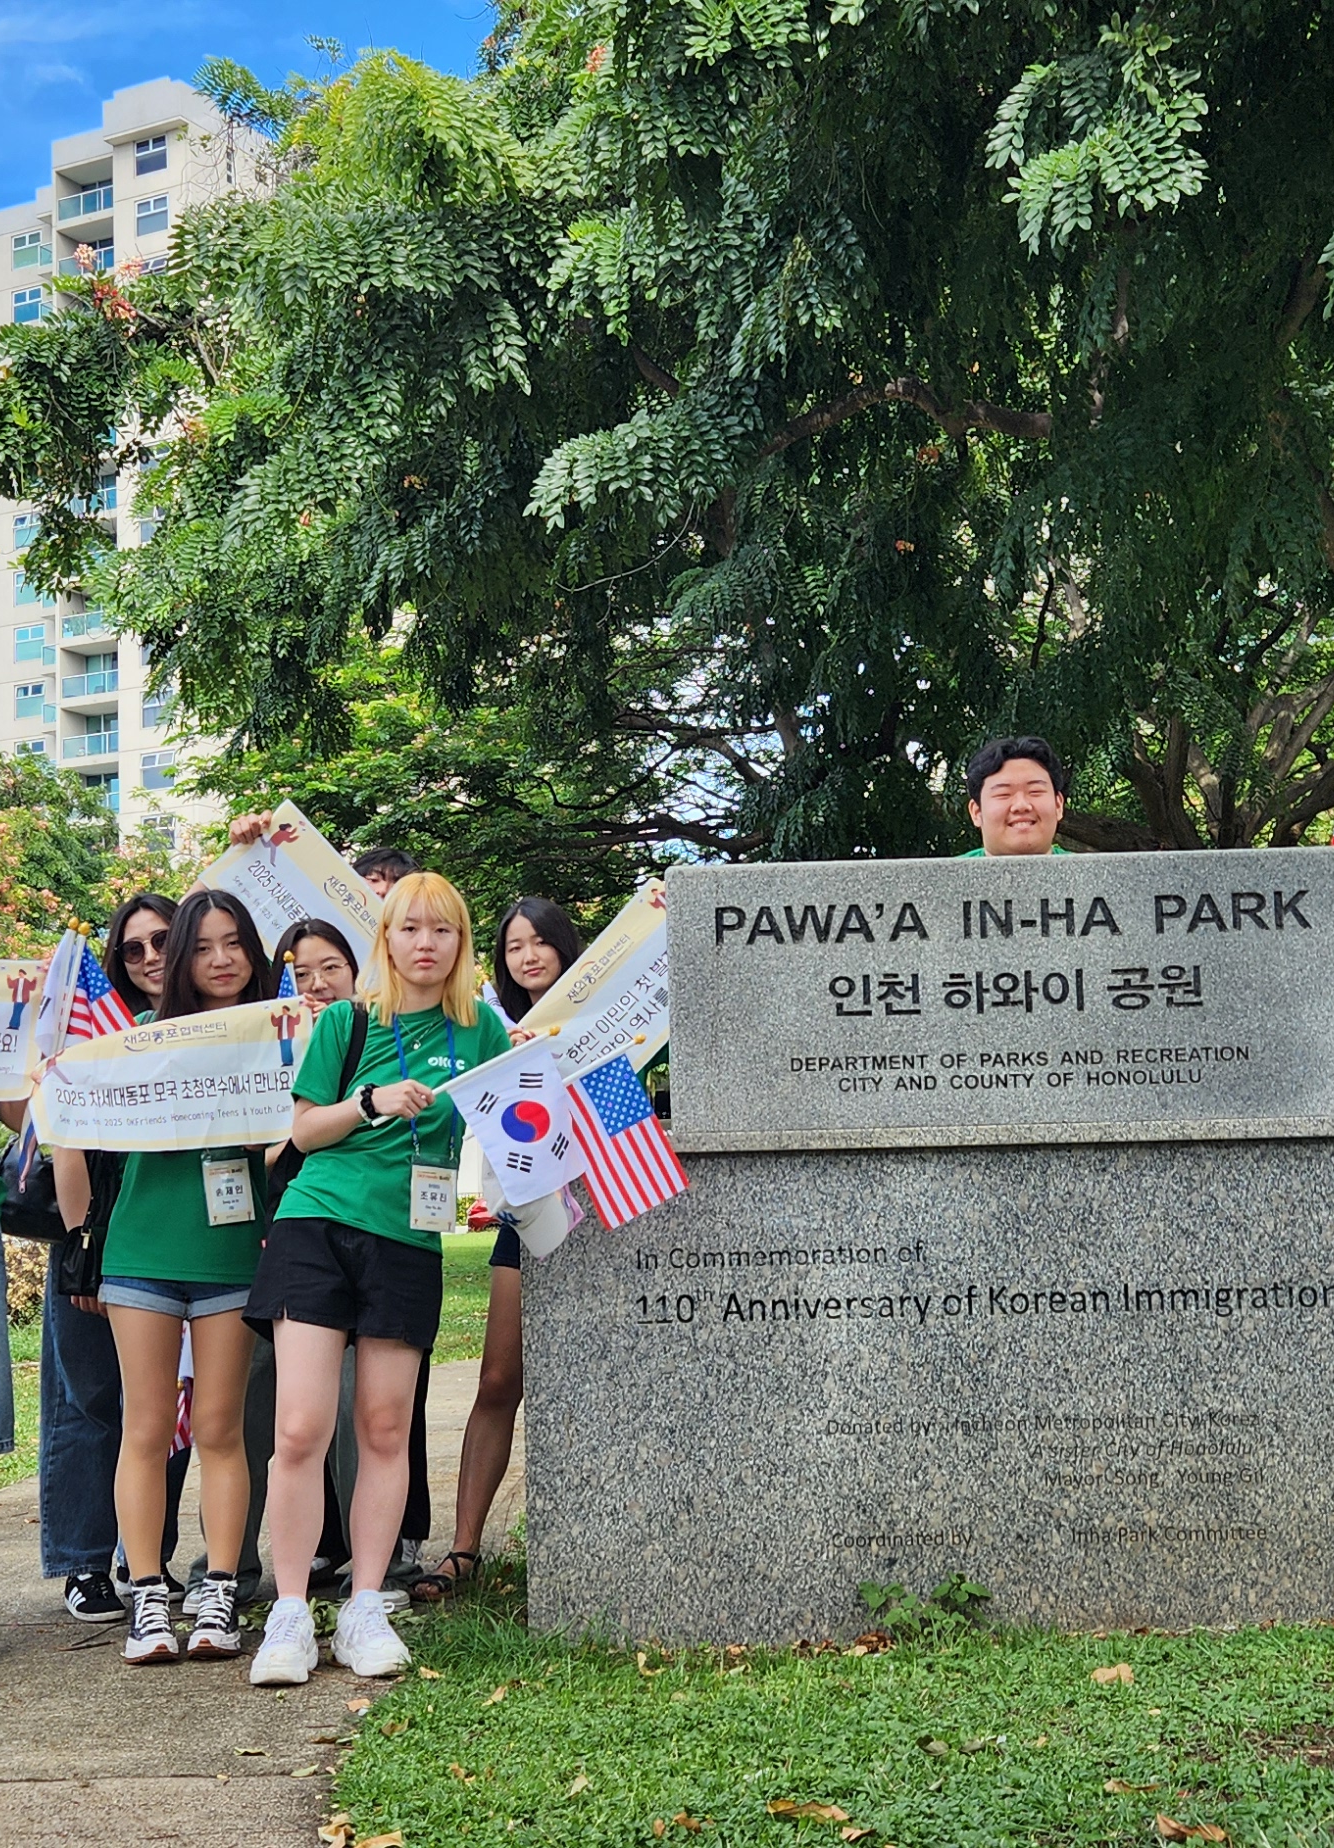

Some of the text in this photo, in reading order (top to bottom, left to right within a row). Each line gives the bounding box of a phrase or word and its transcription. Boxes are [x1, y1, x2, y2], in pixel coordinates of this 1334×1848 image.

[248, 860, 275, 889] 2025
[327, 875, 378, 934] 재외동포협력
[963, 897, 1123, 939] IN-HA
[1154, 889, 1312, 934] PARK
[828, 963, 1205, 1018] 인천 하와이 공원
[566, 1031, 600, 1064] 한인
[595, 990, 639, 1034] 이민의
[790, 1045, 1250, 1073] DEPARTMENT OF PARKS AND RECREATION
[56, 1088, 86, 1107] 2025
[88, 1084, 151, 1107] 차세대동포
[154, 1080, 178, 1101] 모국
[181, 1074, 251, 1099] 초청연수에서
[838, 1068, 1203, 1092] CITY AND COUNTY OF HONOLULU
[104, 1118, 123, 1127] 2025
[217, 1108, 239, 1118] Teens
[250, 1105, 273, 1116] Youth
[636, 1242, 925, 1270] In Commemoration of
[722, 1290, 931, 1325] Anniversary
[943, 1285, 977, 1316] of
[989, 1285, 1110, 1315] Korean
[1118, 1526, 1159, 1543] Park
